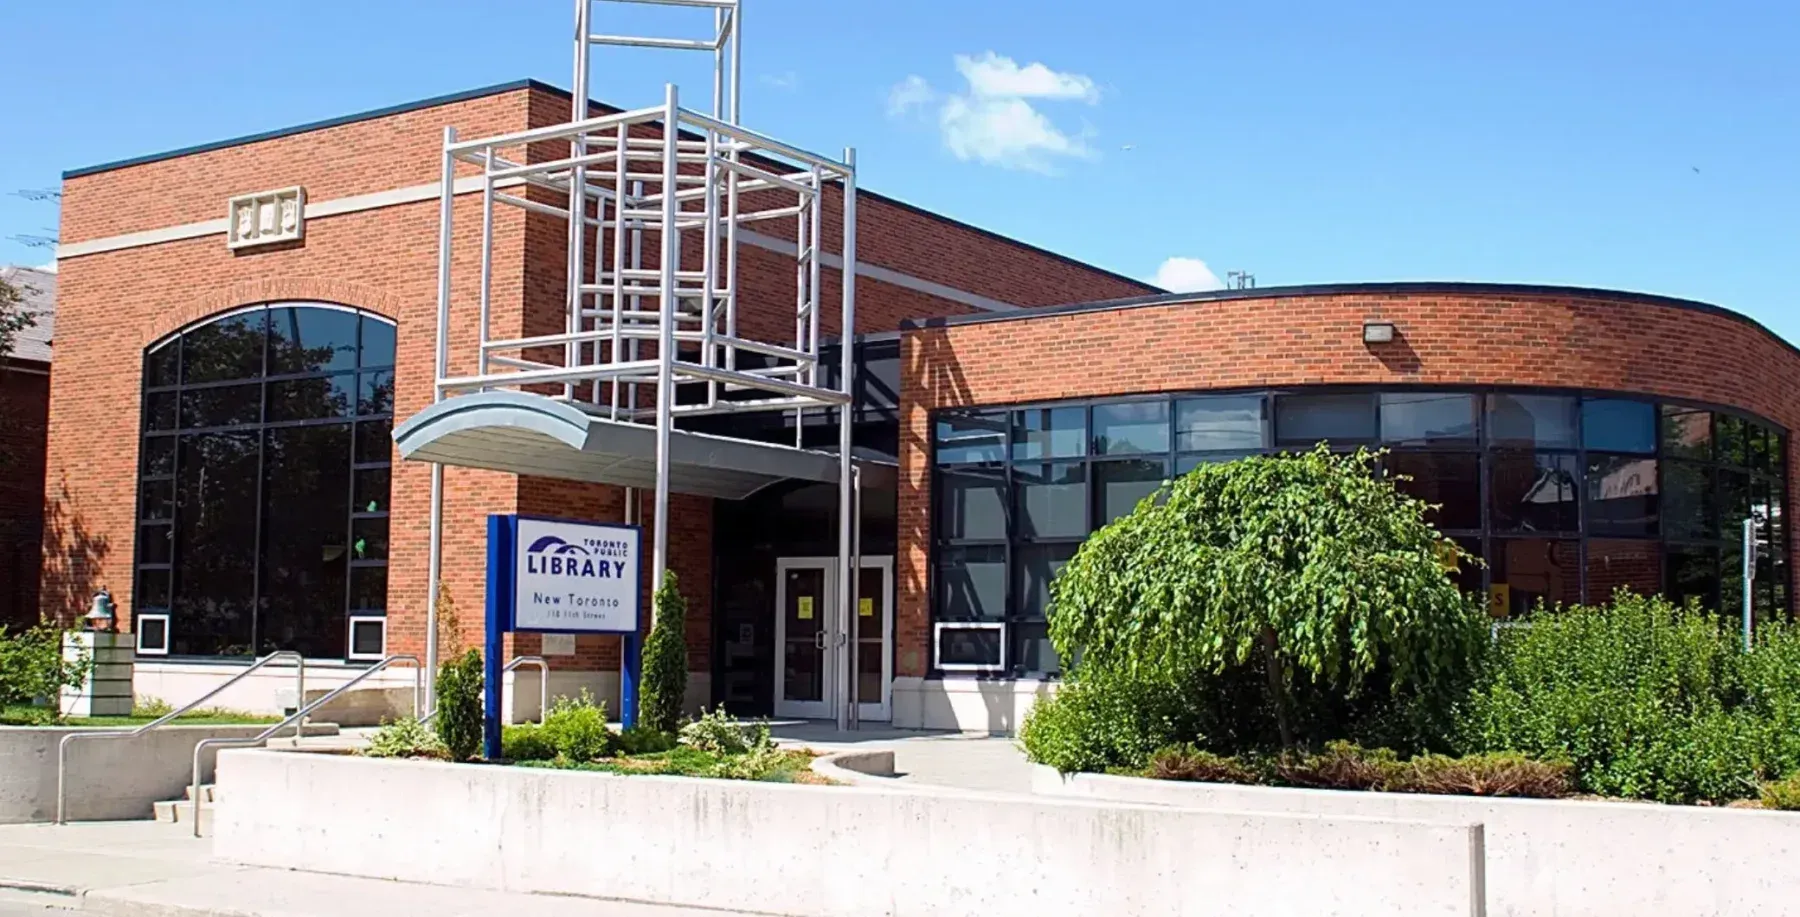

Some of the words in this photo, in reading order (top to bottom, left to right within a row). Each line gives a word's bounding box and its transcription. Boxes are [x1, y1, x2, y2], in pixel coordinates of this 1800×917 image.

[584, 538, 628, 549] TORONTO
[594, 547, 628, 557] PUBLIC
[528, 555, 625, 578] LIBRARY
[534, 592, 561, 604] New
[568, 593, 619, 607] Toronto
